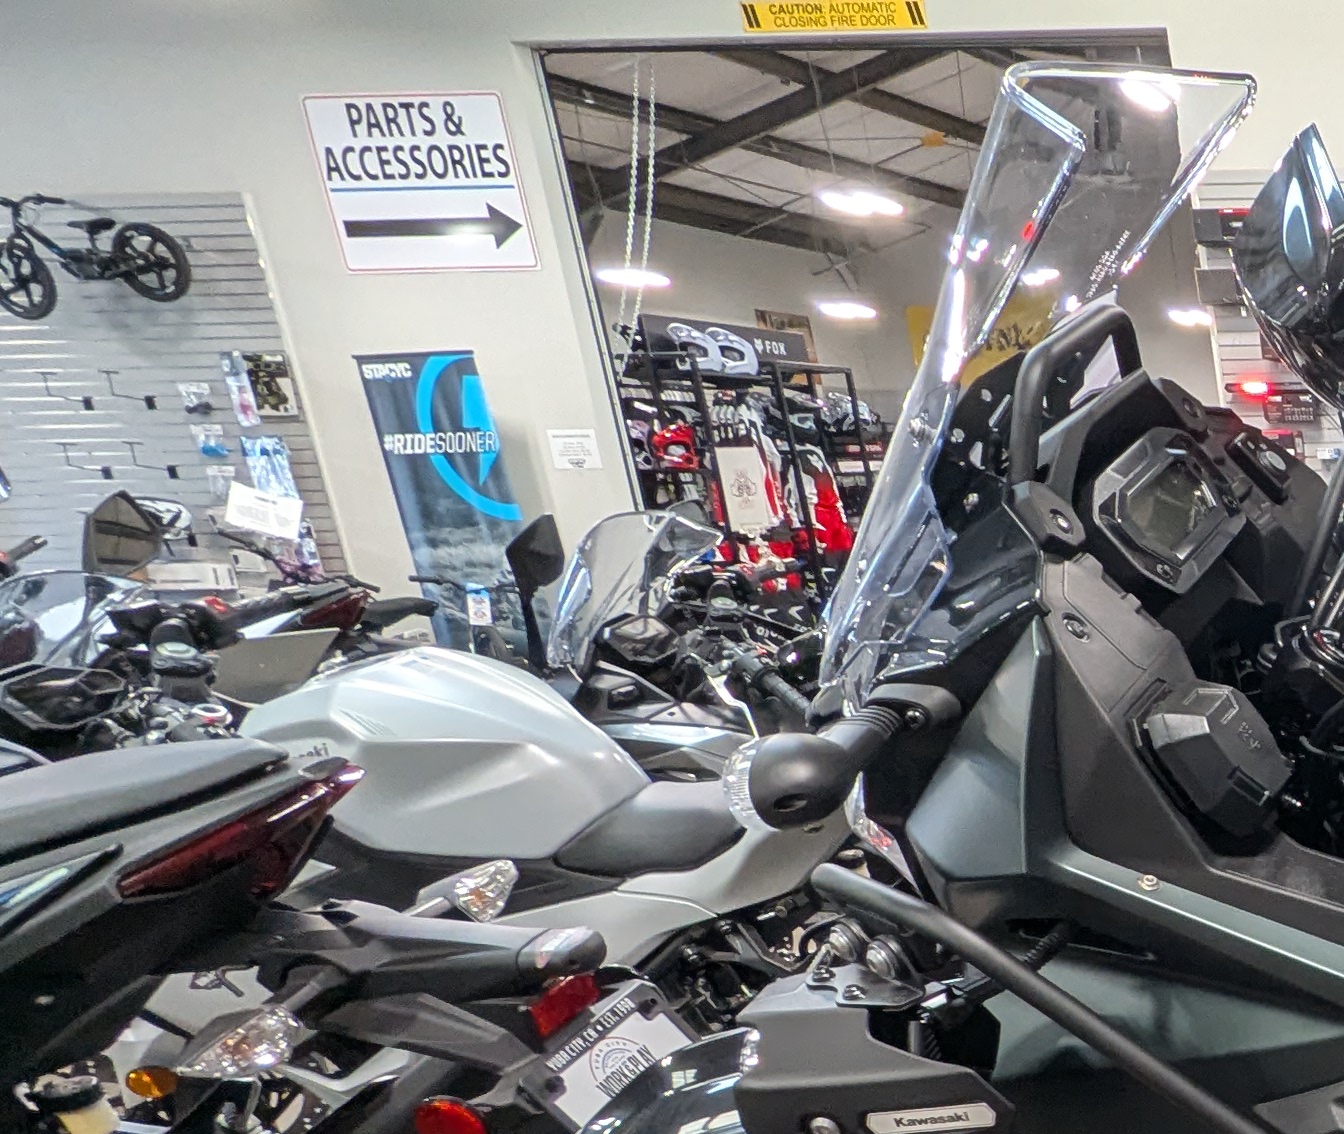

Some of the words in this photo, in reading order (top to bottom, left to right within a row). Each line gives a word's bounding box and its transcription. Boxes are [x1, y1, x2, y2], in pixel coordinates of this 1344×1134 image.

[828, 2, 897, 14] AUTOMATIC
[774, 15, 828, 27] CLOSING
[831, 15, 857, 26] FIRE
[860, 14, 896, 26] DOOR
[345, 101, 436, 138] PARTS
[442, 101, 466, 137] &
[324, 143, 511, 182] ACCESSORIES
[764, 340, 787, 356] FOX
[362, 362, 412, 380] STACYC
[383, 431, 499, 455] #RIDESOONER
[545, 1051, 572, 1072] YUBA
[893, 1111, 970, 1128] Kawasaki
